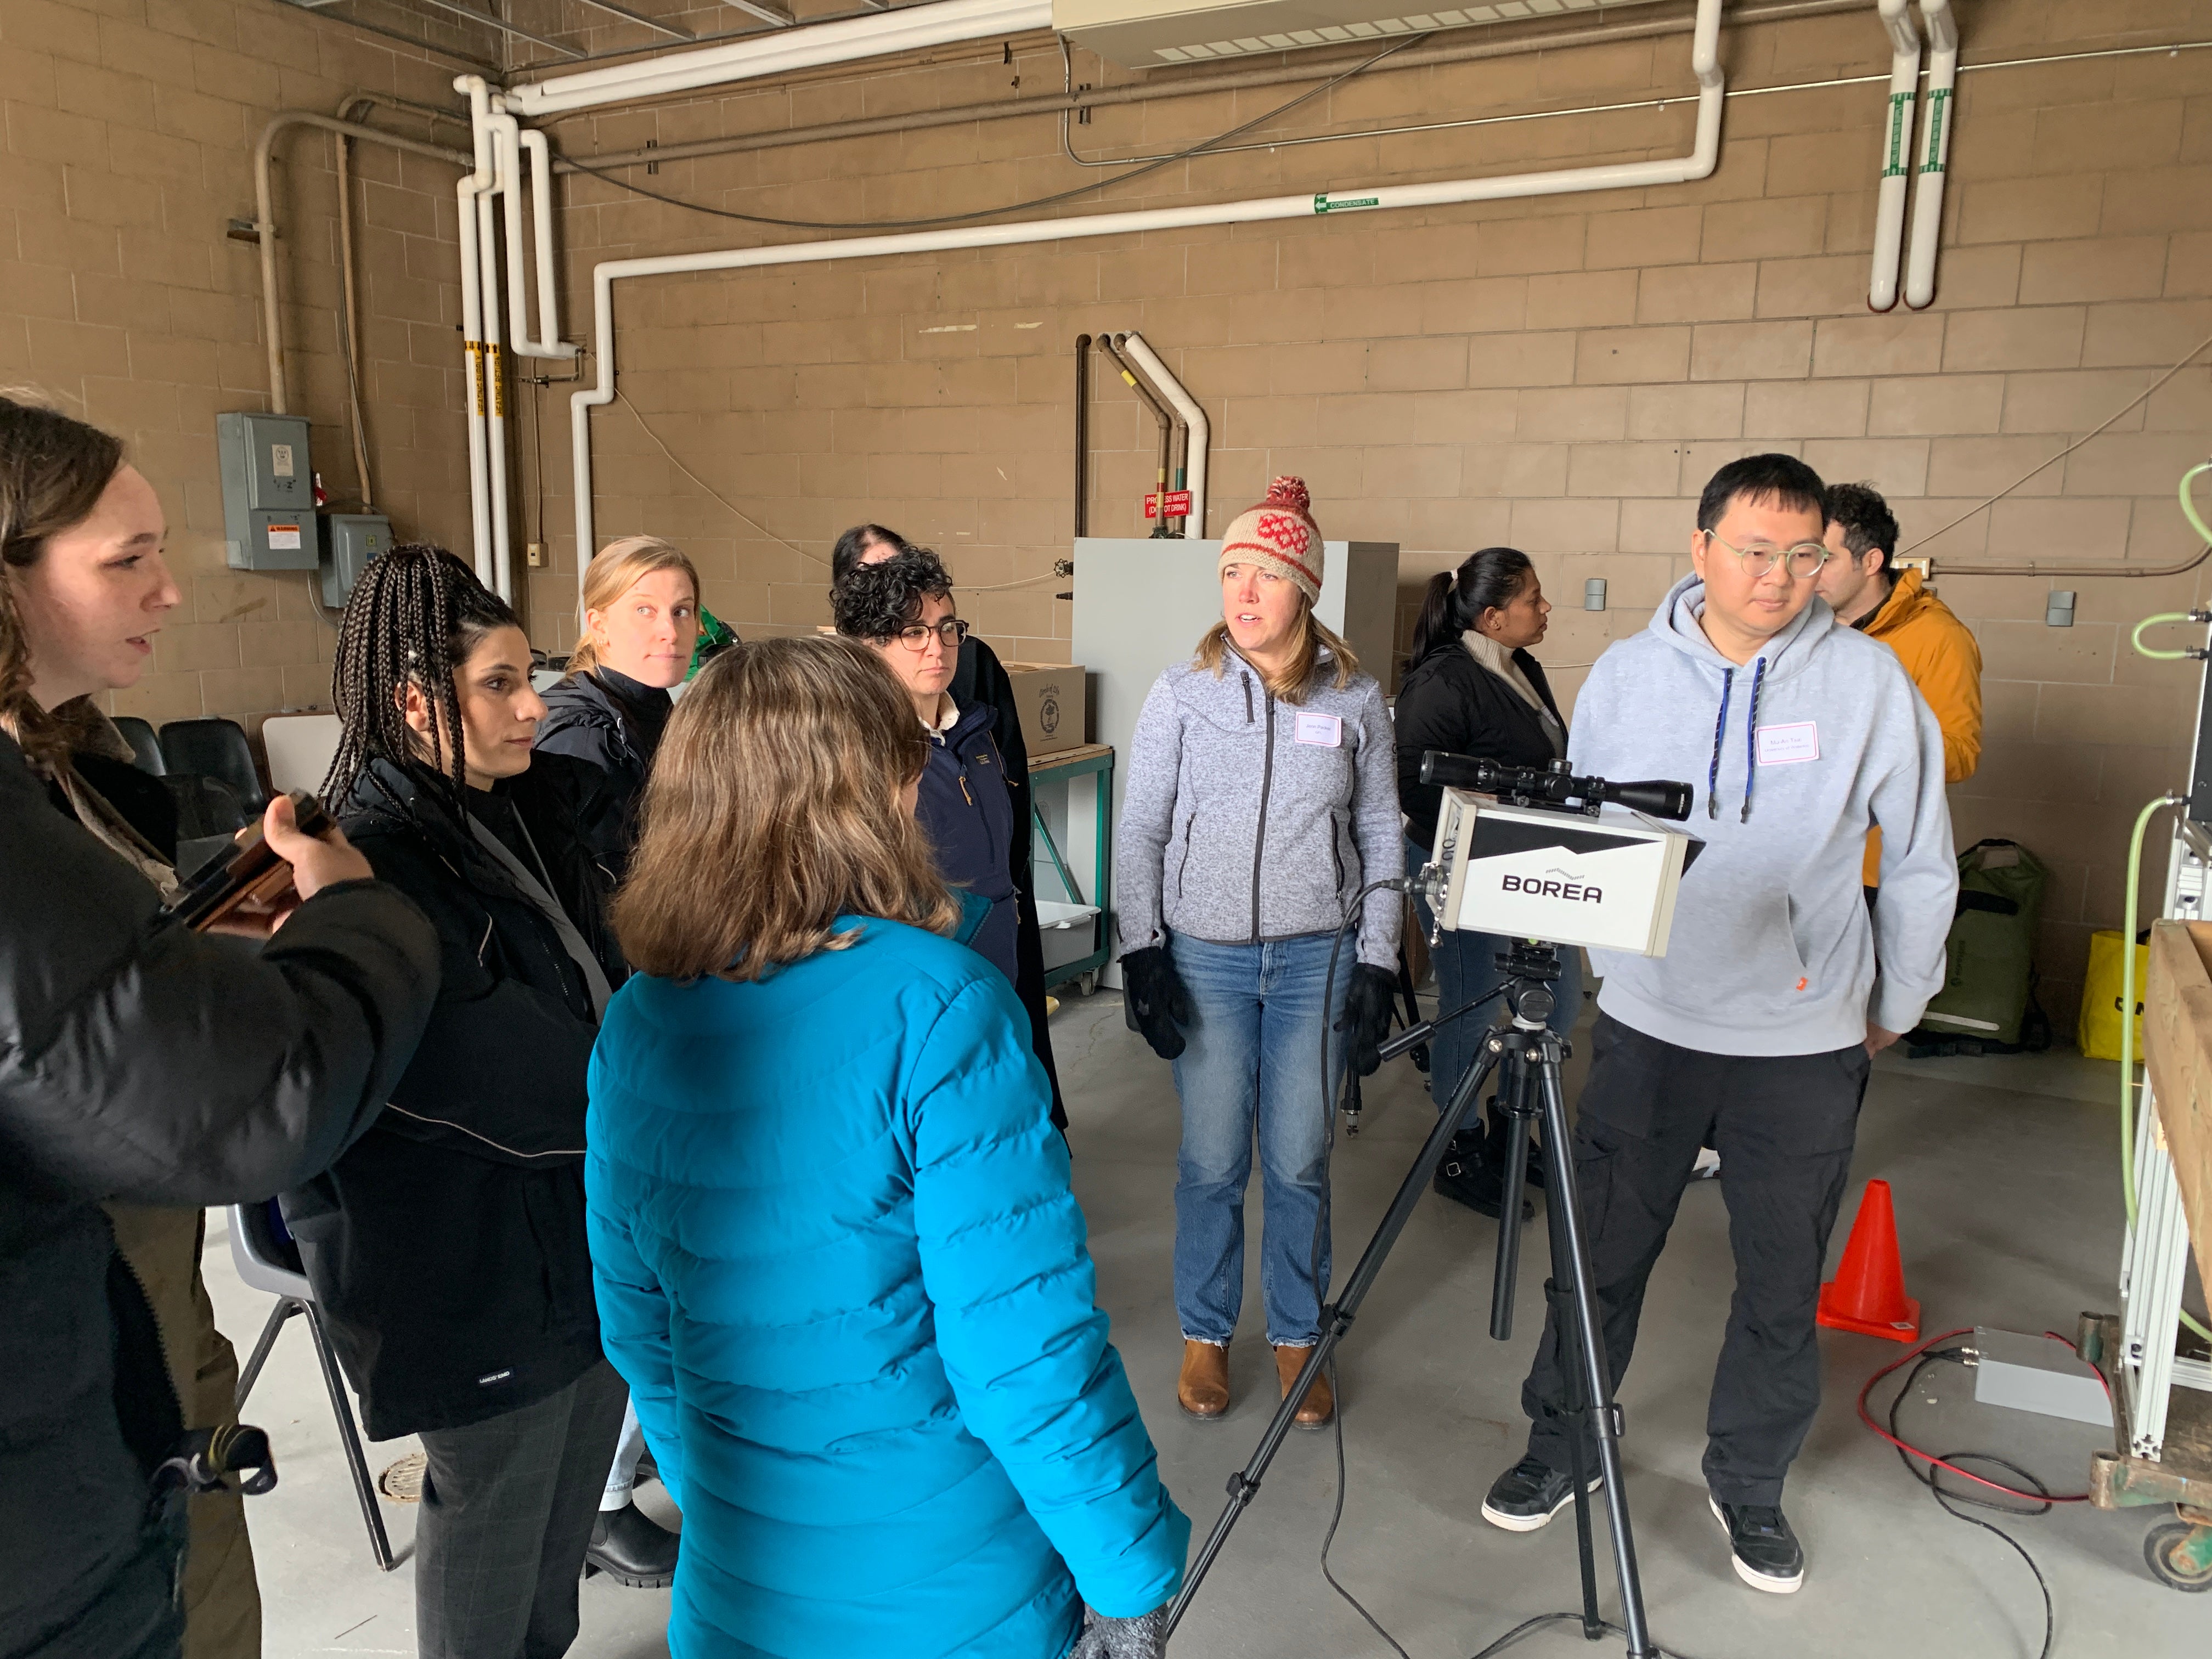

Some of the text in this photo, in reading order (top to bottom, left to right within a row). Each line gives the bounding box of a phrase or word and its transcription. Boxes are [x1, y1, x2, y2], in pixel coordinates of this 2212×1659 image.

[1330, 199, 1375, 208] CONDENSATE
[1172, 493, 1188, 502] WATER
[1171, 503, 1187, 512] DRINK)
[1502, 874, 1602, 904] BOREA
